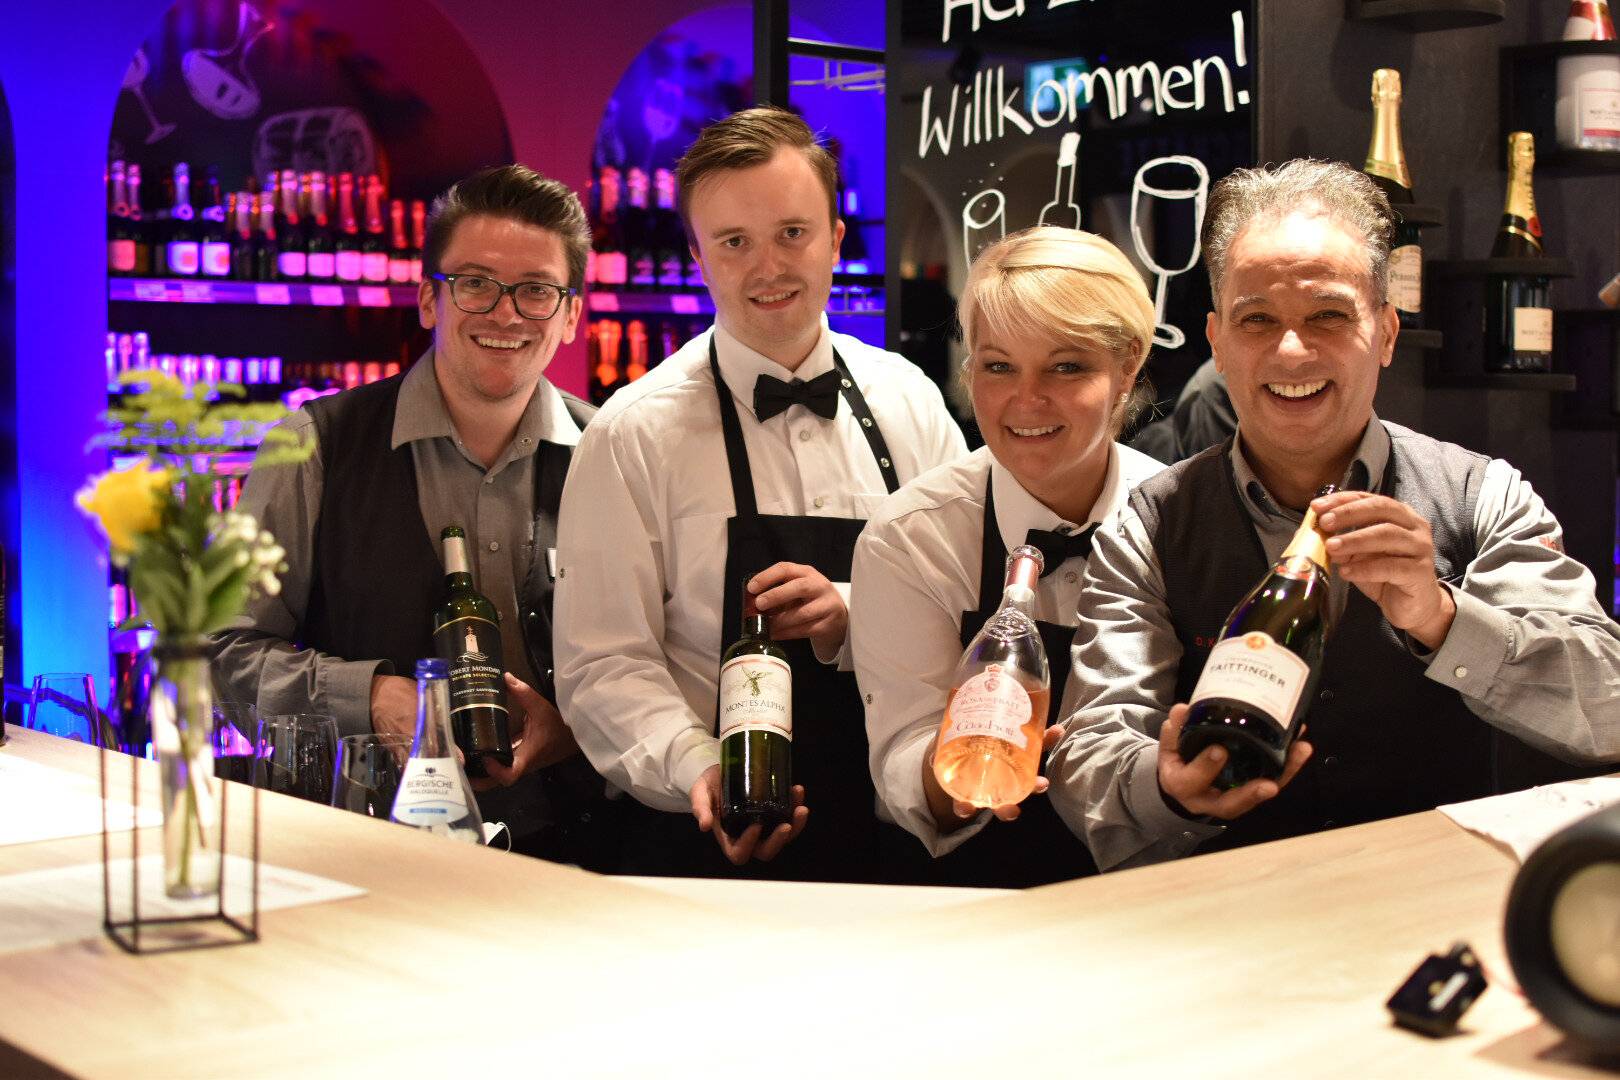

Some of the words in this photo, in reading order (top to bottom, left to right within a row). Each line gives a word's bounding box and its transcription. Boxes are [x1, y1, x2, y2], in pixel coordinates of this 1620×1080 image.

[919, 10, 1251, 159] Willkommen!
[450, 665, 471, 676] OBERT
[1209, 662, 1286, 688] TAITTINGER
